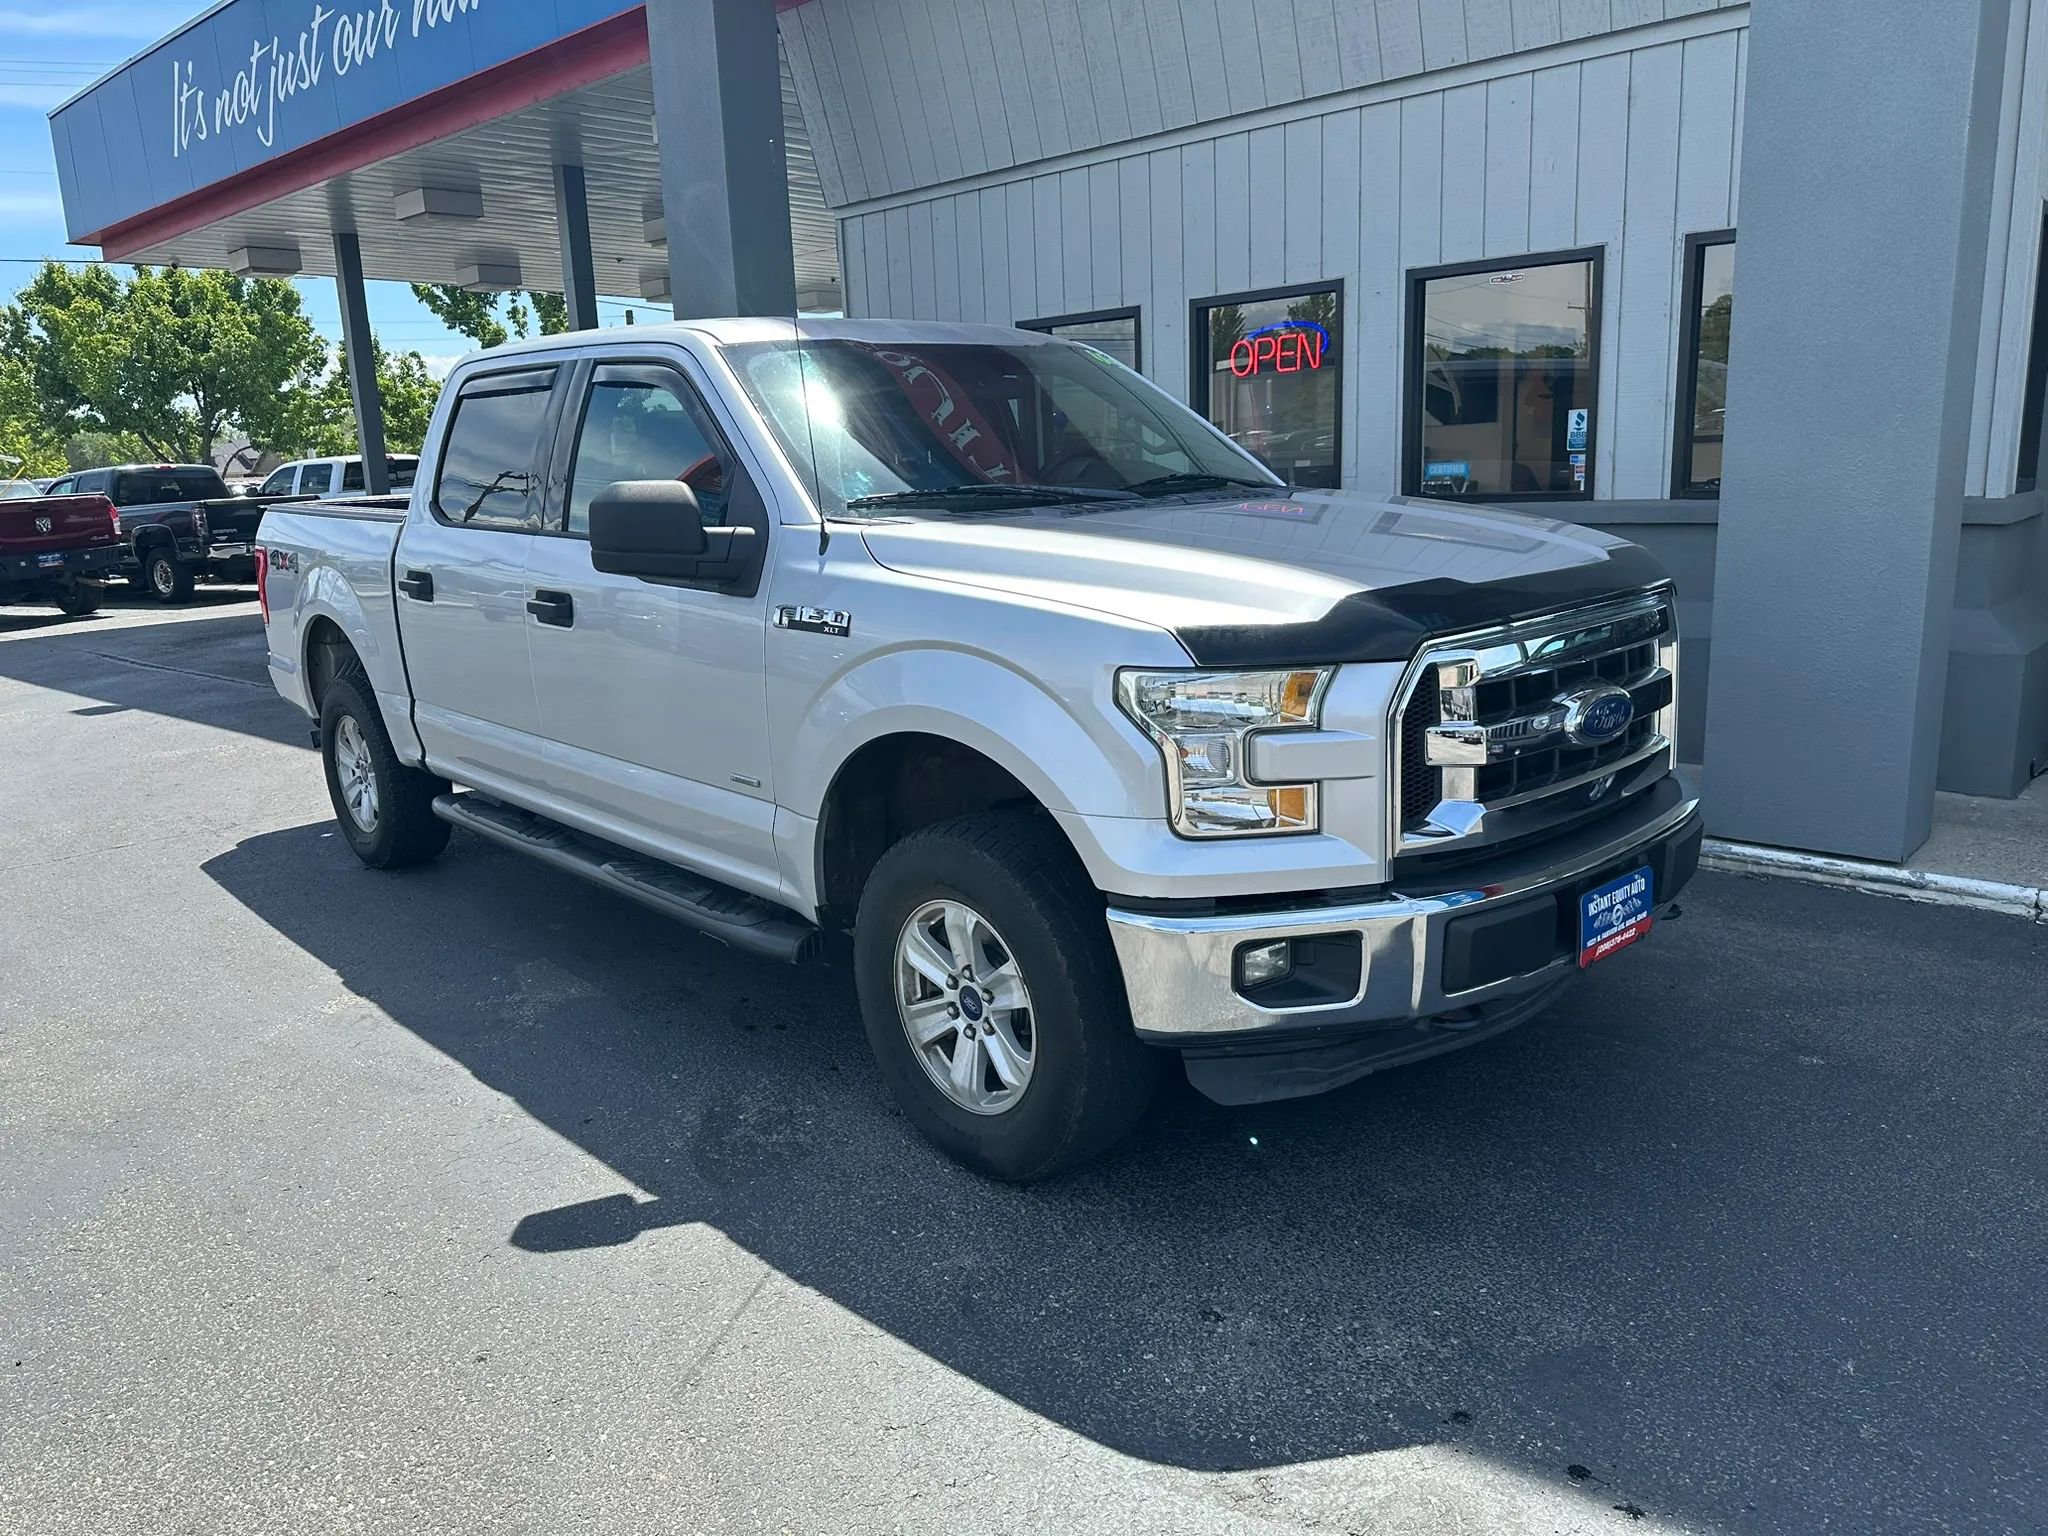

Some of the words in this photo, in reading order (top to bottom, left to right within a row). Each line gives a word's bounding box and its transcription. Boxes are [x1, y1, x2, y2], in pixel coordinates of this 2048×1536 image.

[173, 60, 207, 158] It's
[215, 39, 271, 135] not
[256, 3, 335, 148] just
[333, 0, 400, 76] our
[1230, 331, 1322, 377] OPEN
[823, 626, 840, 634] XLT
[1588, 893, 1611, 917] INSTANT
[1612, 883, 1631, 905] EQUITY
[1631, 877, 1645, 896] AUTO
